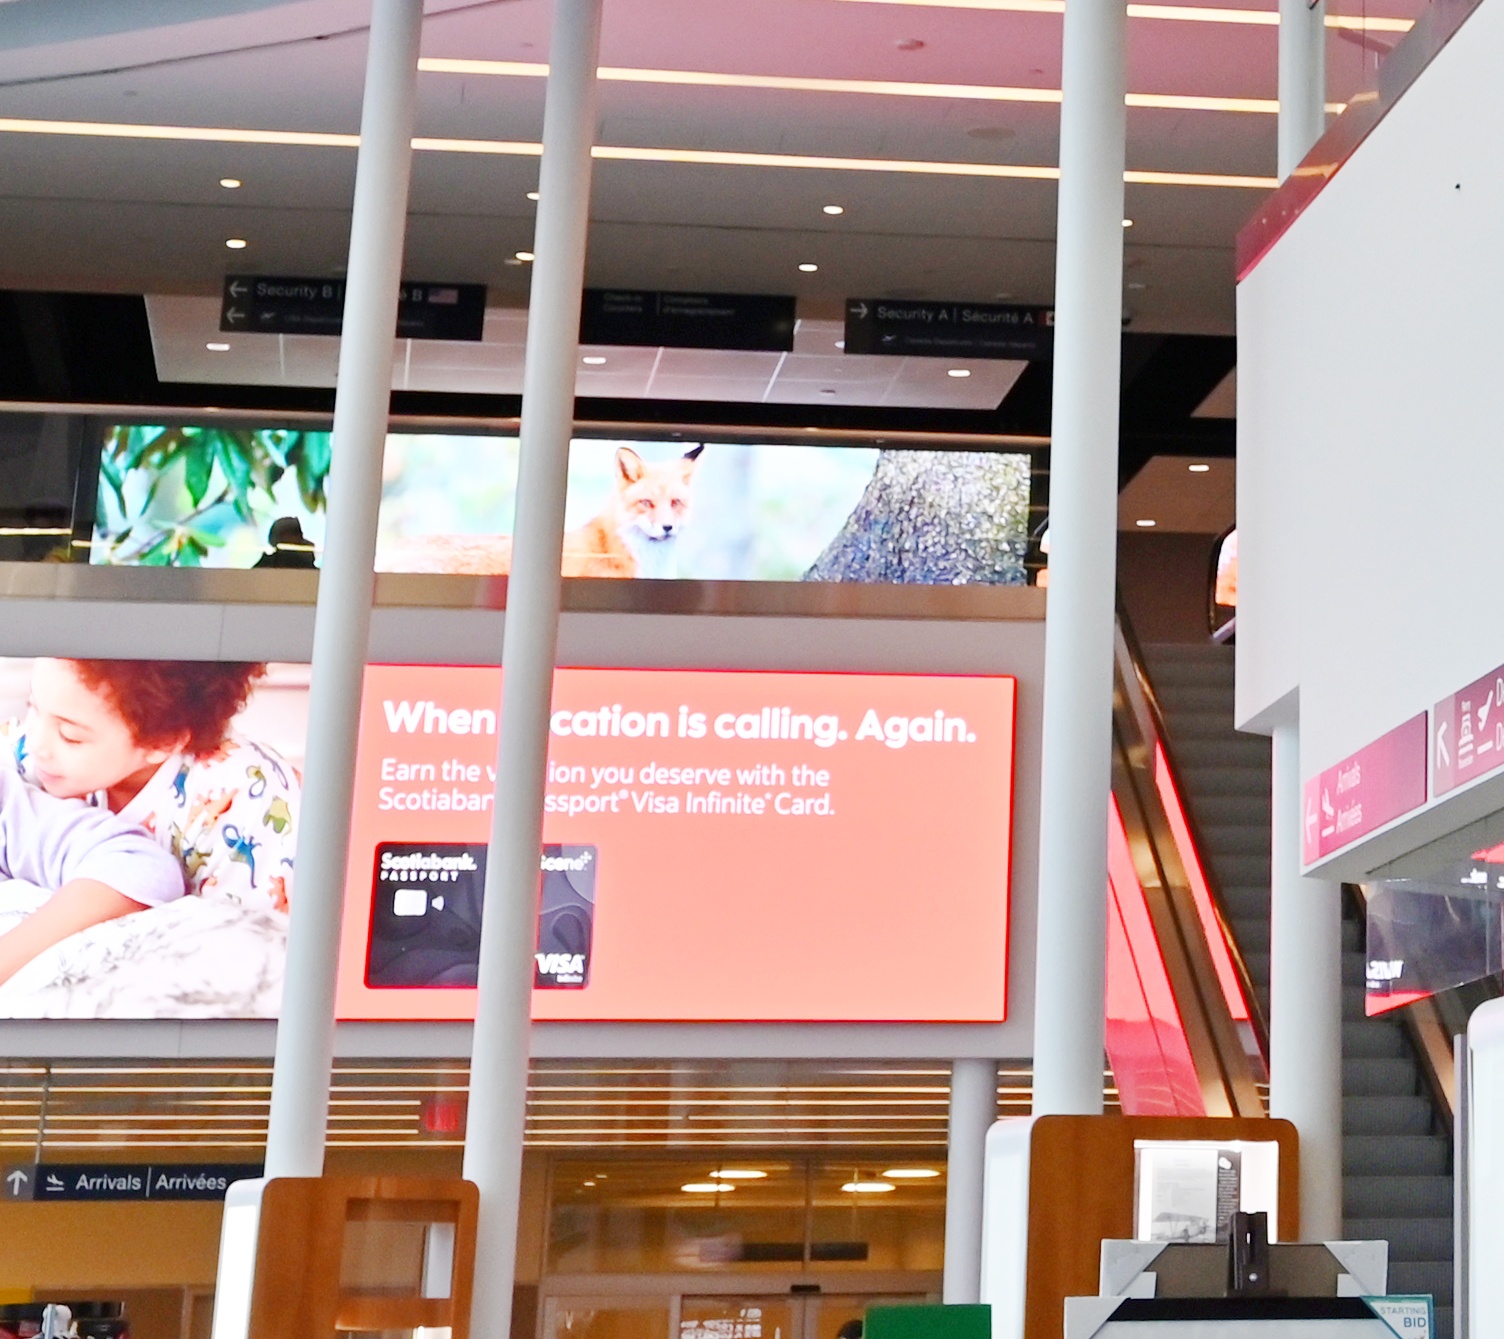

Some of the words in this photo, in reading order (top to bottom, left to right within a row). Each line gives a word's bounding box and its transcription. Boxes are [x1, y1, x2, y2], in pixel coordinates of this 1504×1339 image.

[877, 306, 934, 322] Security
[383, 700, 496, 734] When
[549, 704, 670, 737] cation
[677, 705, 707, 738] is
[714, 706, 848, 748] calling.
[854, 709, 977, 749] Again.
[381, 758, 435, 782] Earn
[441, 758, 481, 783] the
[590, 765, 634, 789] you
[639, 761, 732, 785] deserve
[736, 763, 786, 787] with
[791, 764, 830, 787] the
[378, 786, 495, 812] Scotiaban
[631, 790, 680, 813] Visa
[774, 792, 835, 816] Card.
[380, 871, 459, 882] PASSPORT
[534, 953, 586, 974] VISA
[75, 1173, 142, 1191] Arrivals
[155, 1173, 227, 1191] Arrivées
[1380, 1307, 1426, 1315] STARTING
[1404, 1317, 1427, 1327] BID
